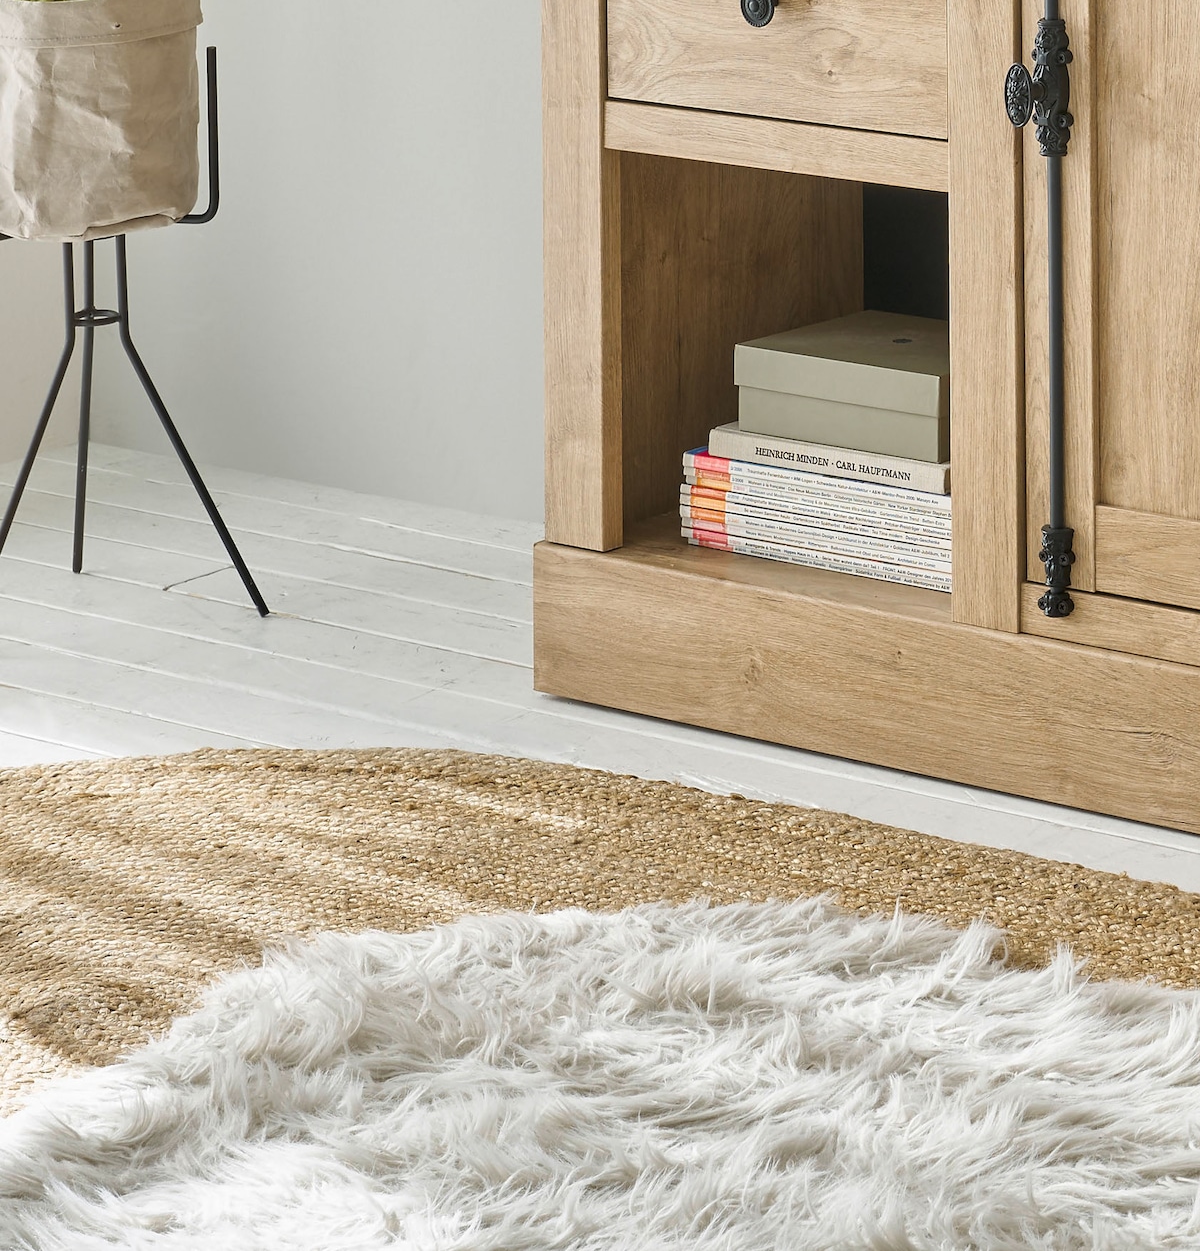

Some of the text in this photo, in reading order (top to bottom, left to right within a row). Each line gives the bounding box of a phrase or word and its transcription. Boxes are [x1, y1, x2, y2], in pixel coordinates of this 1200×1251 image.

[755, 447, 911, 480] HEINRICH MINDEN CARL HAUPTMANN
